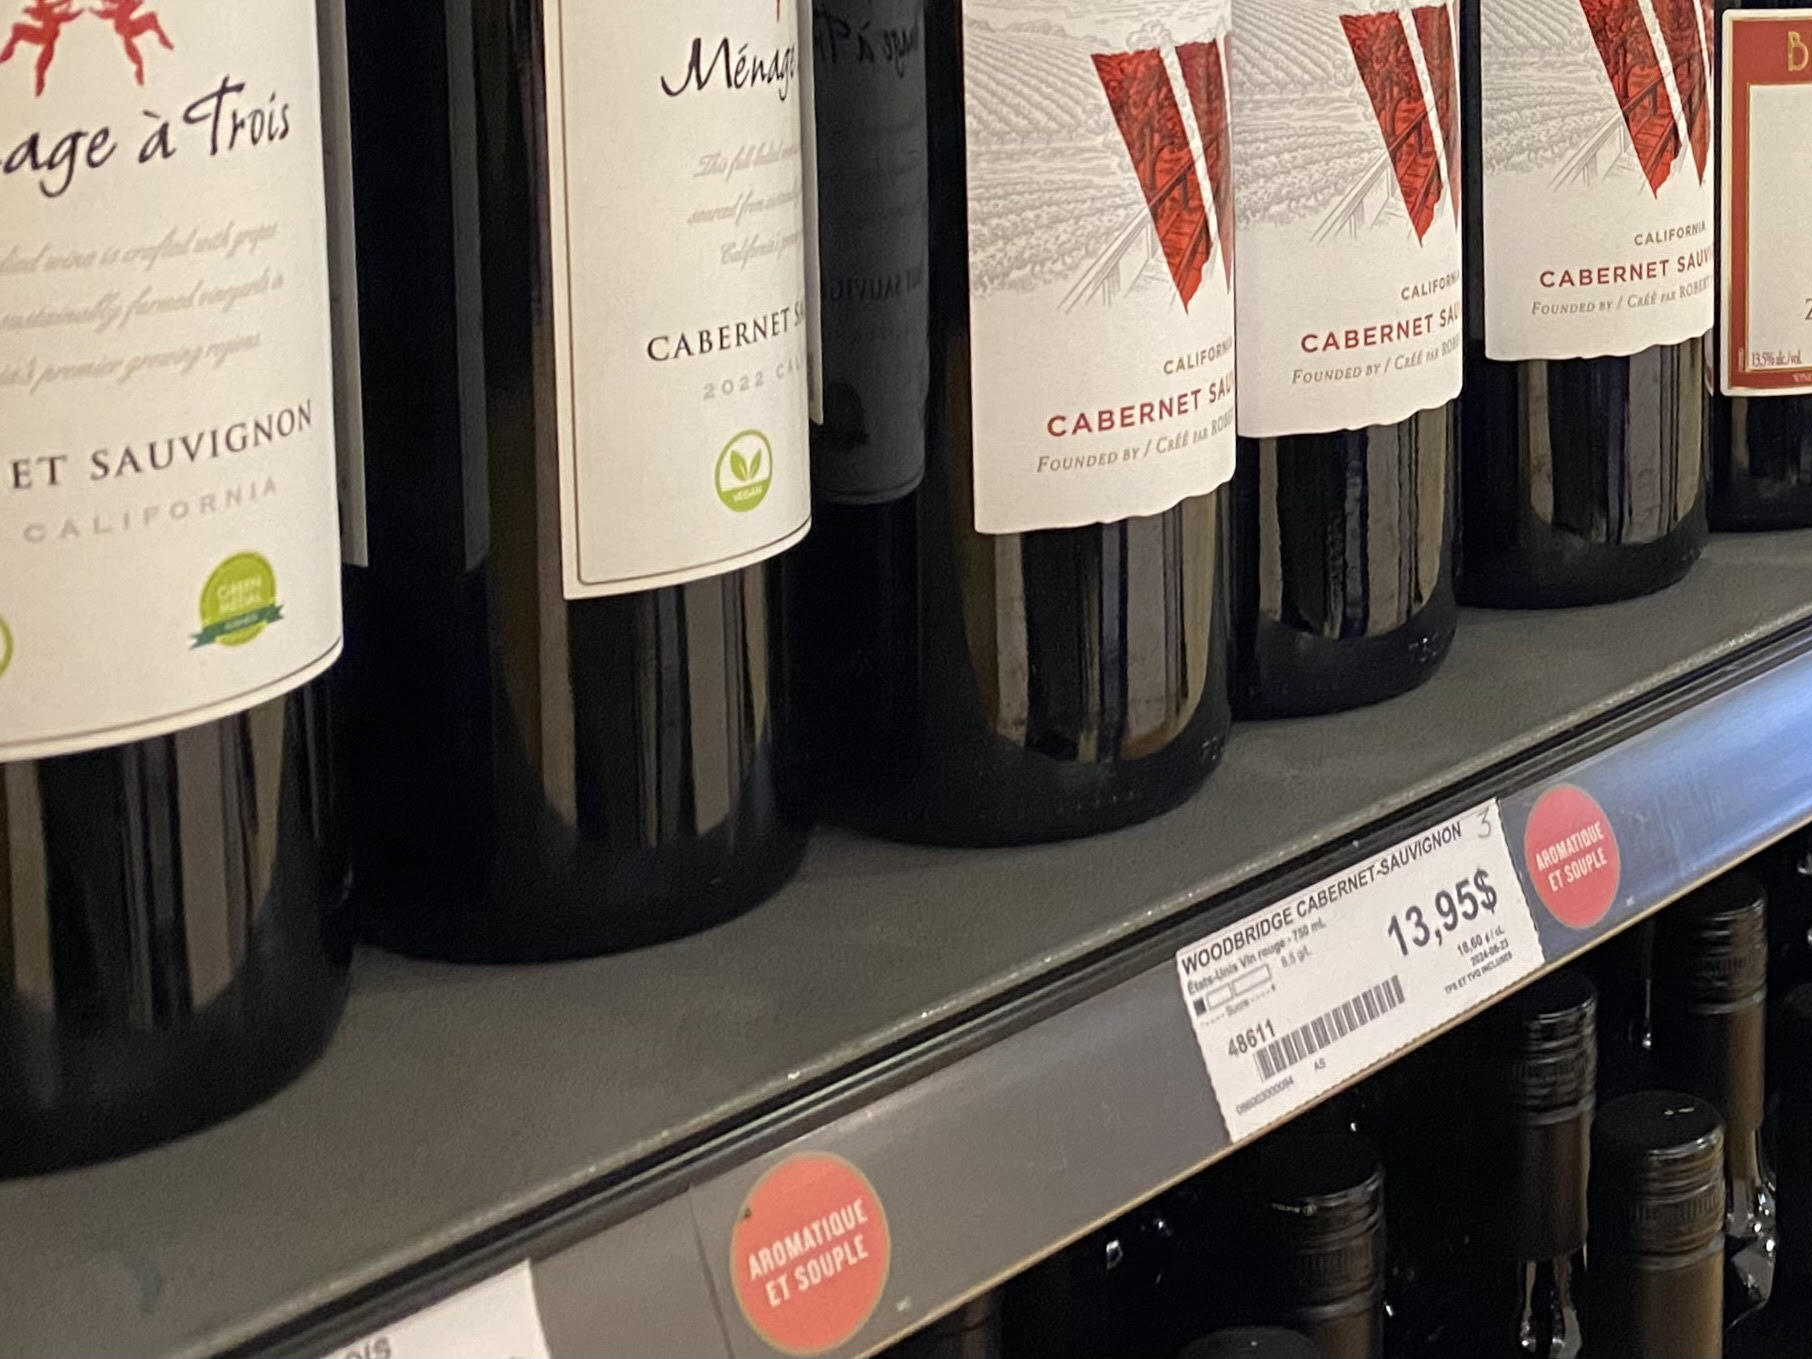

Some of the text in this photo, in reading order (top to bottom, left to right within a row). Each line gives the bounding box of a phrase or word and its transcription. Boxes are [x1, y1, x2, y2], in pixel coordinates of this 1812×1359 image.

[138, 110, 176, 164] à
[183, 76, 291, 155] Trois
[1539, 259, 1670, 289] CABERNET
[1531, 300, 1596, 316] FOUNDED
[1599, 299, 1614, 313] BY
[647, 307, 790, 362] CABERNET
[1300, 314, 1433, 354] CABERNET
[703, 371, 764, 400] 2022
[1292, 366, 1361, 385] FOUNDED
[1365, 363, 1381, 378] BY
[1046, 388, 1202, 437] CABERNET
[10, 398, 313, 493] ET SAUVIGNON
[1036, 449, 1118, 474] FOUNDED
[1122, 446, 1141, 463] BY
[23, 475, 279, 543] CALIFORNIA
[1476, 810, 1493, 840] 3
[1535, 821, 1606, 873] AROMATIQUE
[1548, 847, 1608, 893] ET SOUPLE
[1181, 822, 1464, 976] WOODBRIDGE CABERNET-SAUVIGNON
[1388, 866, 1498, 957] 13,95$
[1228, 1018, 1276, 1058] 48611
[747, 1198, 869, 1282] AROMATIQUE
[765, 1233, 869, 1308] ET SOUPLE
